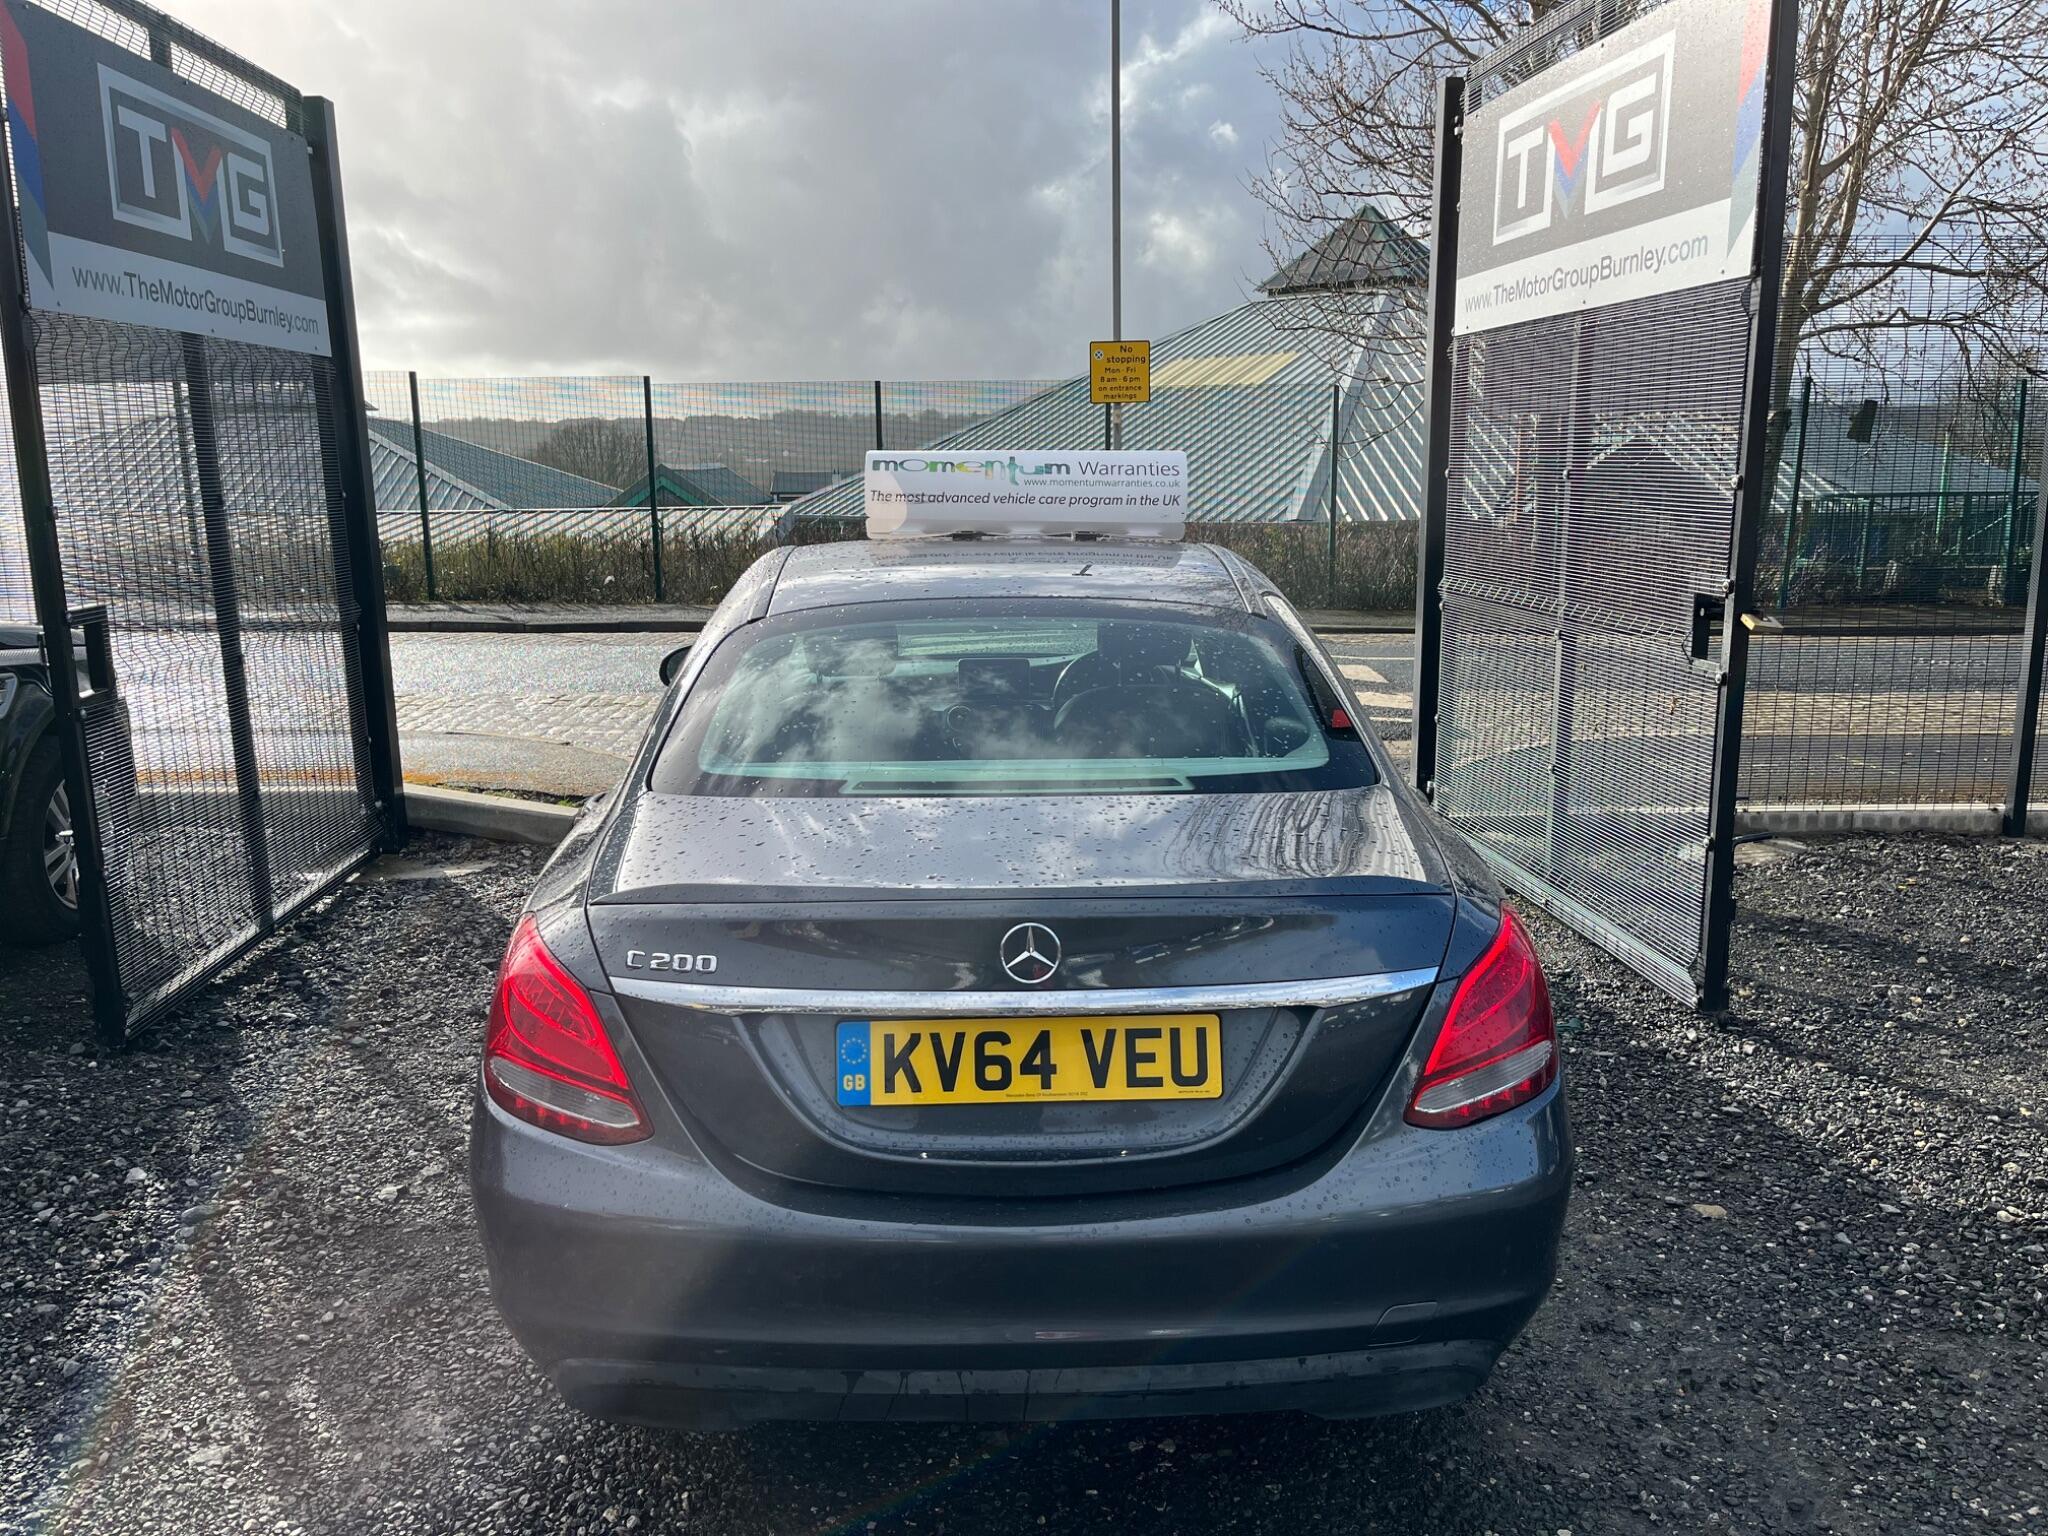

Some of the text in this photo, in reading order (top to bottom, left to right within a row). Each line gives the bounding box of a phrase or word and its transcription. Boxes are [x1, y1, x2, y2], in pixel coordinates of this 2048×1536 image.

[1506, 72, 1657, 219] TMG
[117, 105, 271, 246] TMG
[1465, 235, 1708, 313] www.TheMotorGroupBurnley.com
[72, 266, 319, 335] www.TheMotorGroupBurnley.com
[1106, 355, 1146, 364] stopping
[1120, 345, 1133, 353] No
[872, 456, 1181, 486] momentum Warranties
[1024, 478, 1181, 488] www.momentumwarranties.co.uk
[870, 490, 1181, 508] The most advanced vehicle care program in the UK
[626, 950, 718, 973] C 200
[882, 1026, 1208, 1094] KV64 VEU
[842, 1074, 866, 1091] GB
